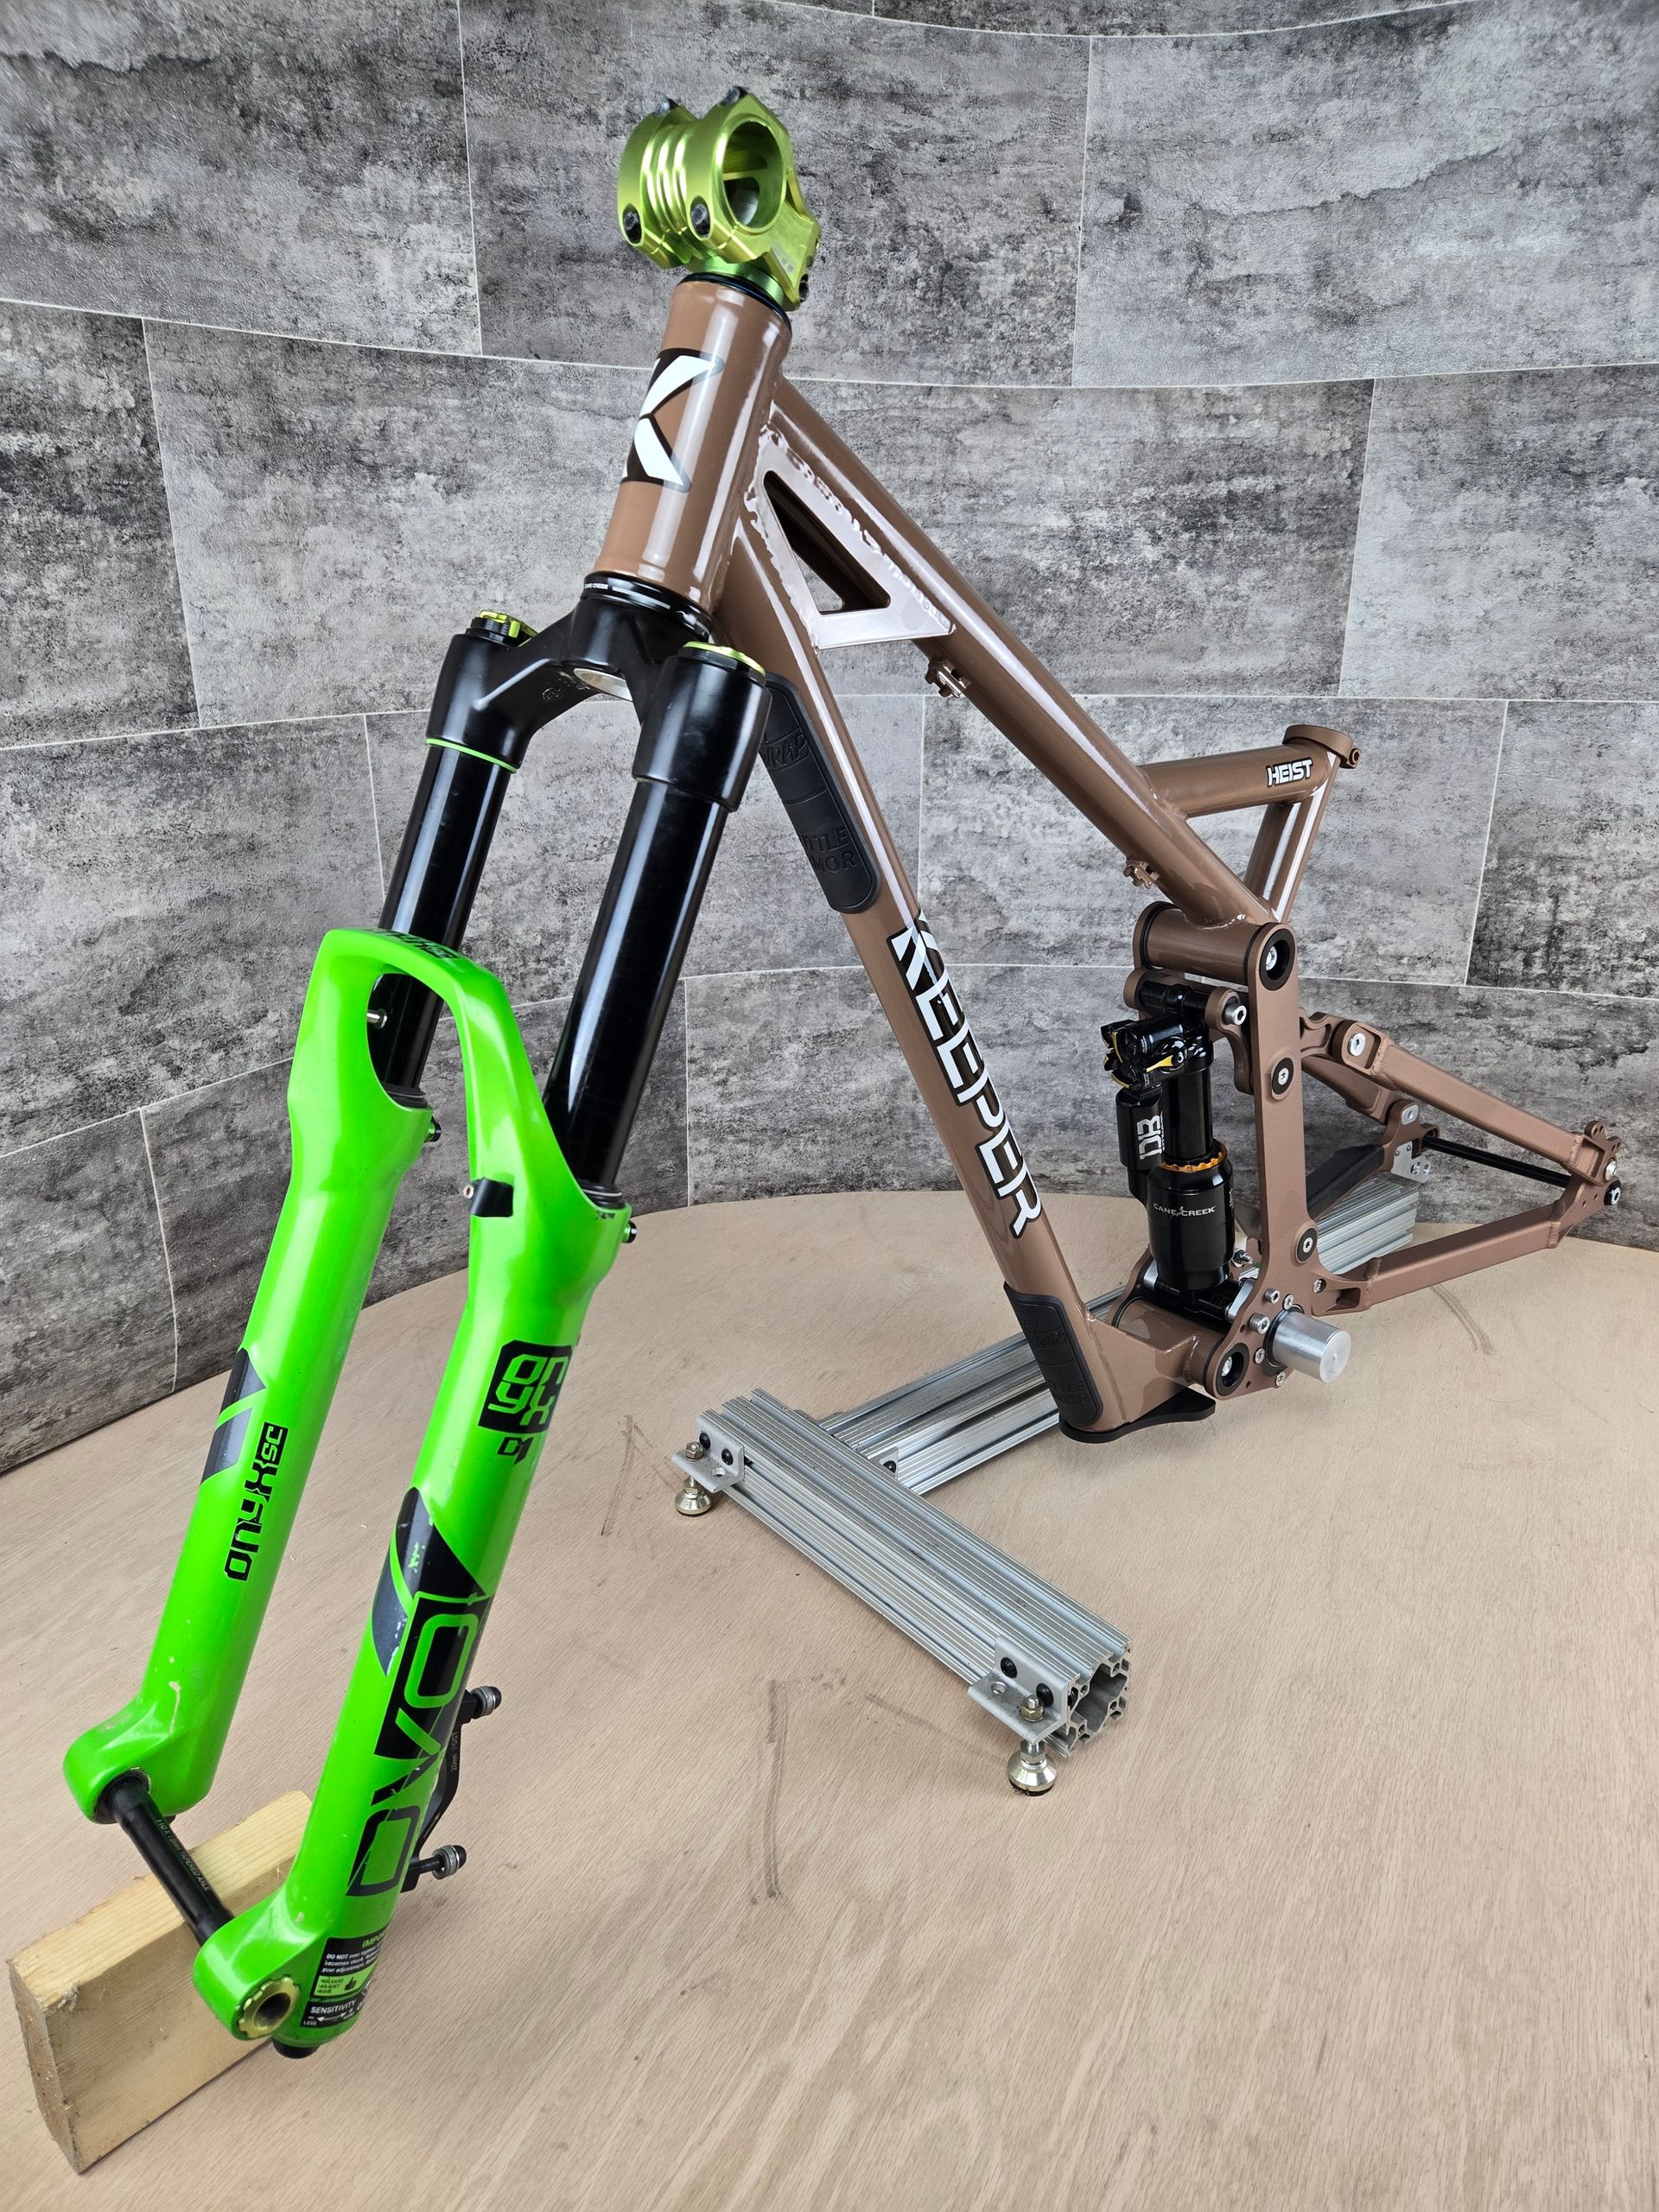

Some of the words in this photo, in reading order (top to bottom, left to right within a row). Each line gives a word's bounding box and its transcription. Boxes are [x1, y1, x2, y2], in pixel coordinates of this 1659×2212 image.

[1267, 759, 1313, 786] HEIST
[888, 909, 1041, 1237] KEEPER
[1154, 1203, 1178, 1216] CANE
[1181, 1205, 1217, 1217] CREEK
[346, 1614, 479, 1897] DVO
[310, 1999, 357, 2014] SENSITIVITY
